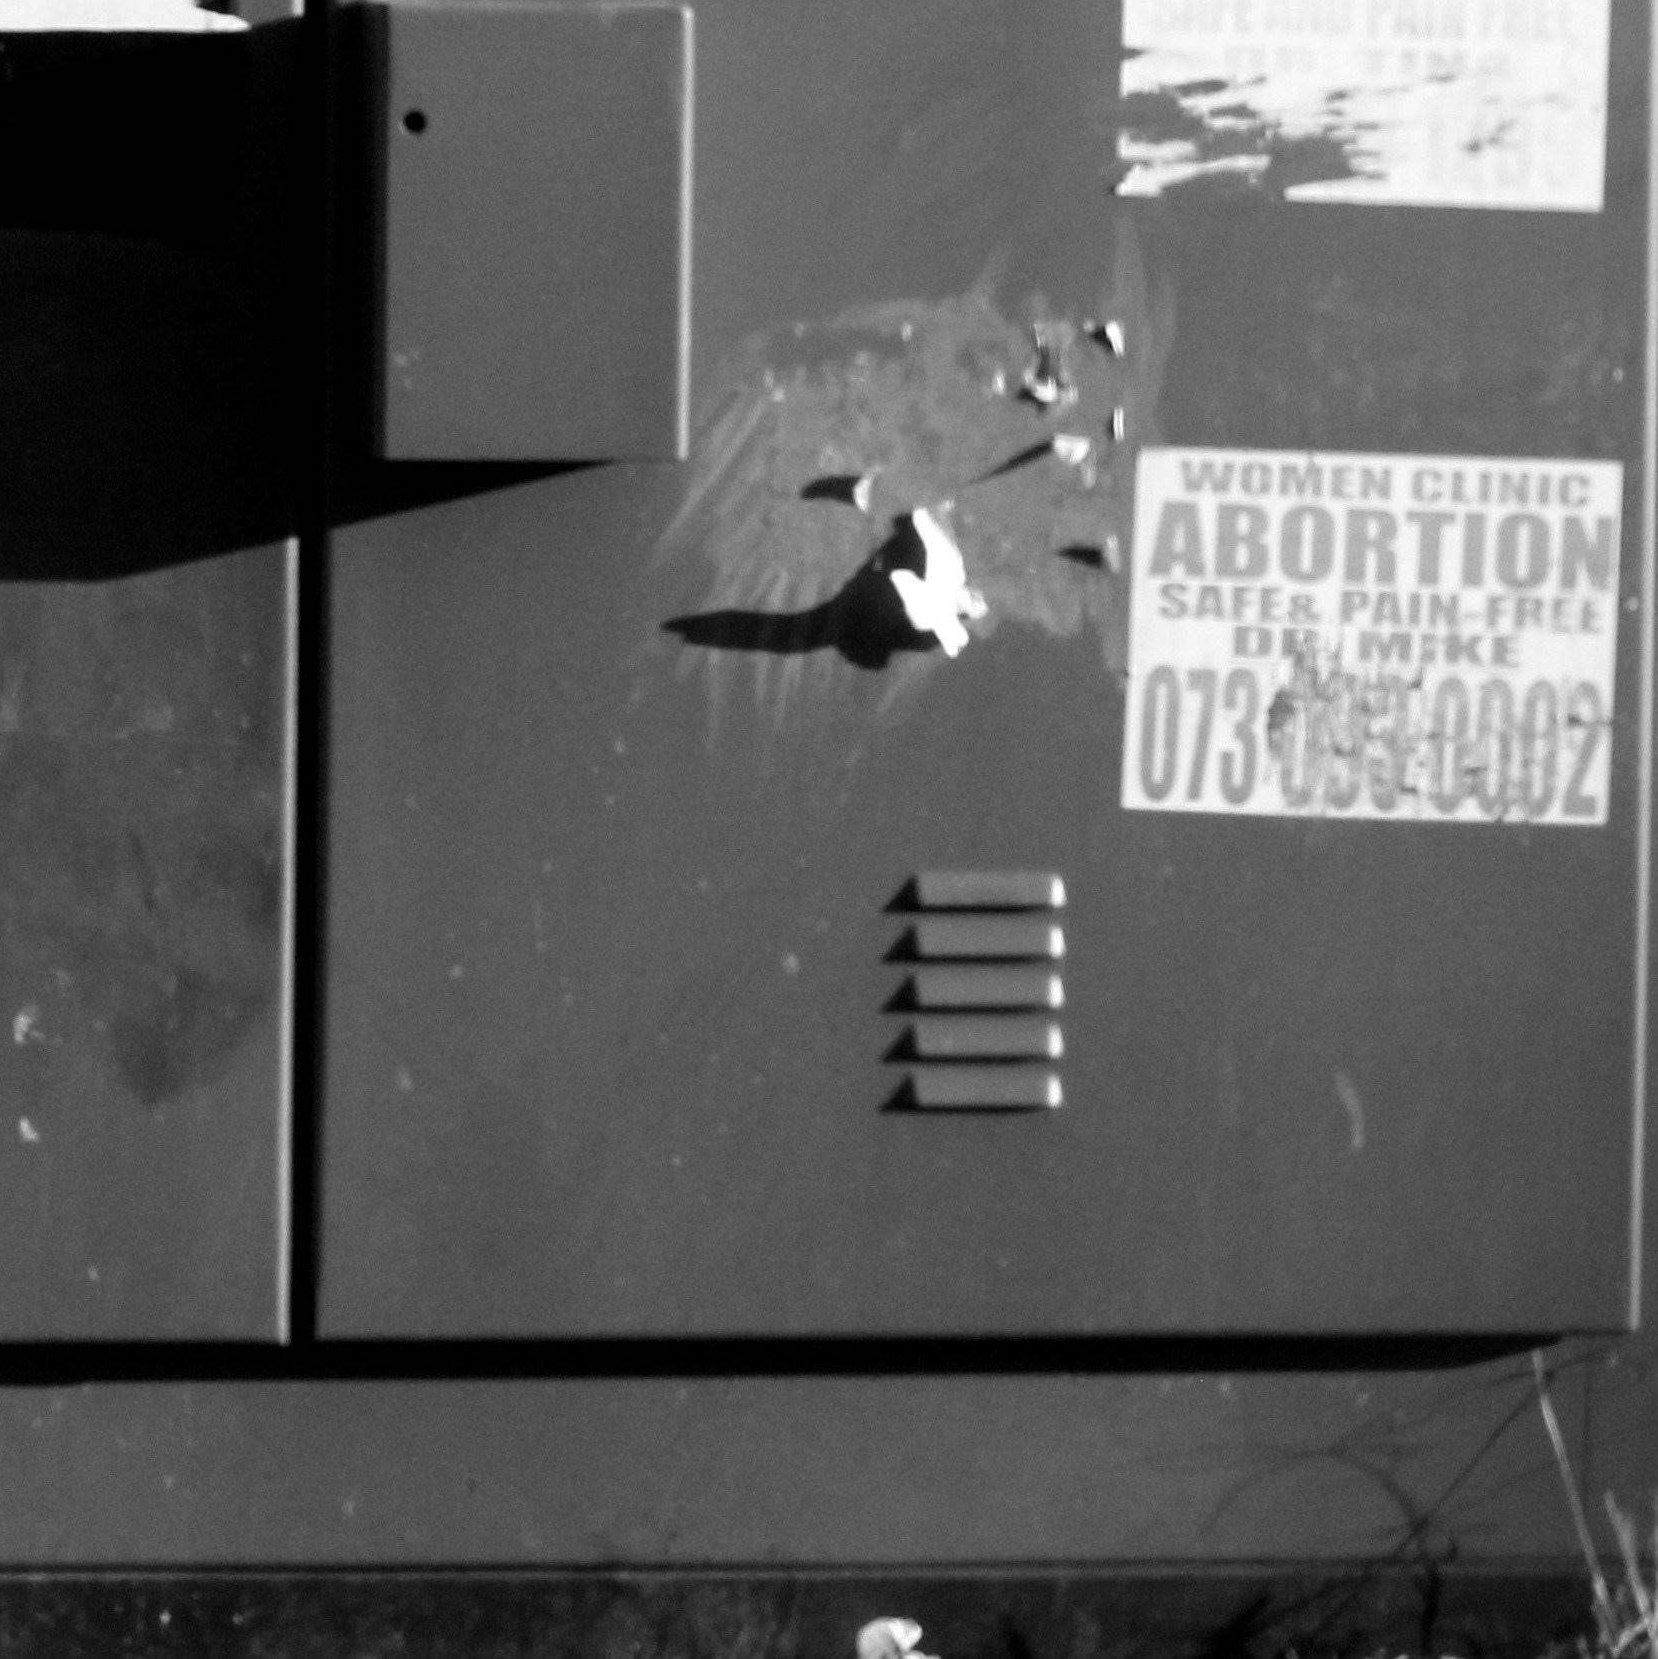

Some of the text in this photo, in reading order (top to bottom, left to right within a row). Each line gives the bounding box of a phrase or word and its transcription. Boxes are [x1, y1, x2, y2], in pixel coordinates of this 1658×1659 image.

[1180, 459, 1592, 509] WOMEN CLINIC
[1148, 499, 1615, 591] ABORTION
[1157, 583, 1604, 635] SAFE& PAIN-FREE
[1358, 630, 1521, 669] MIKE
[1139, 664, 1261, 807] 073
